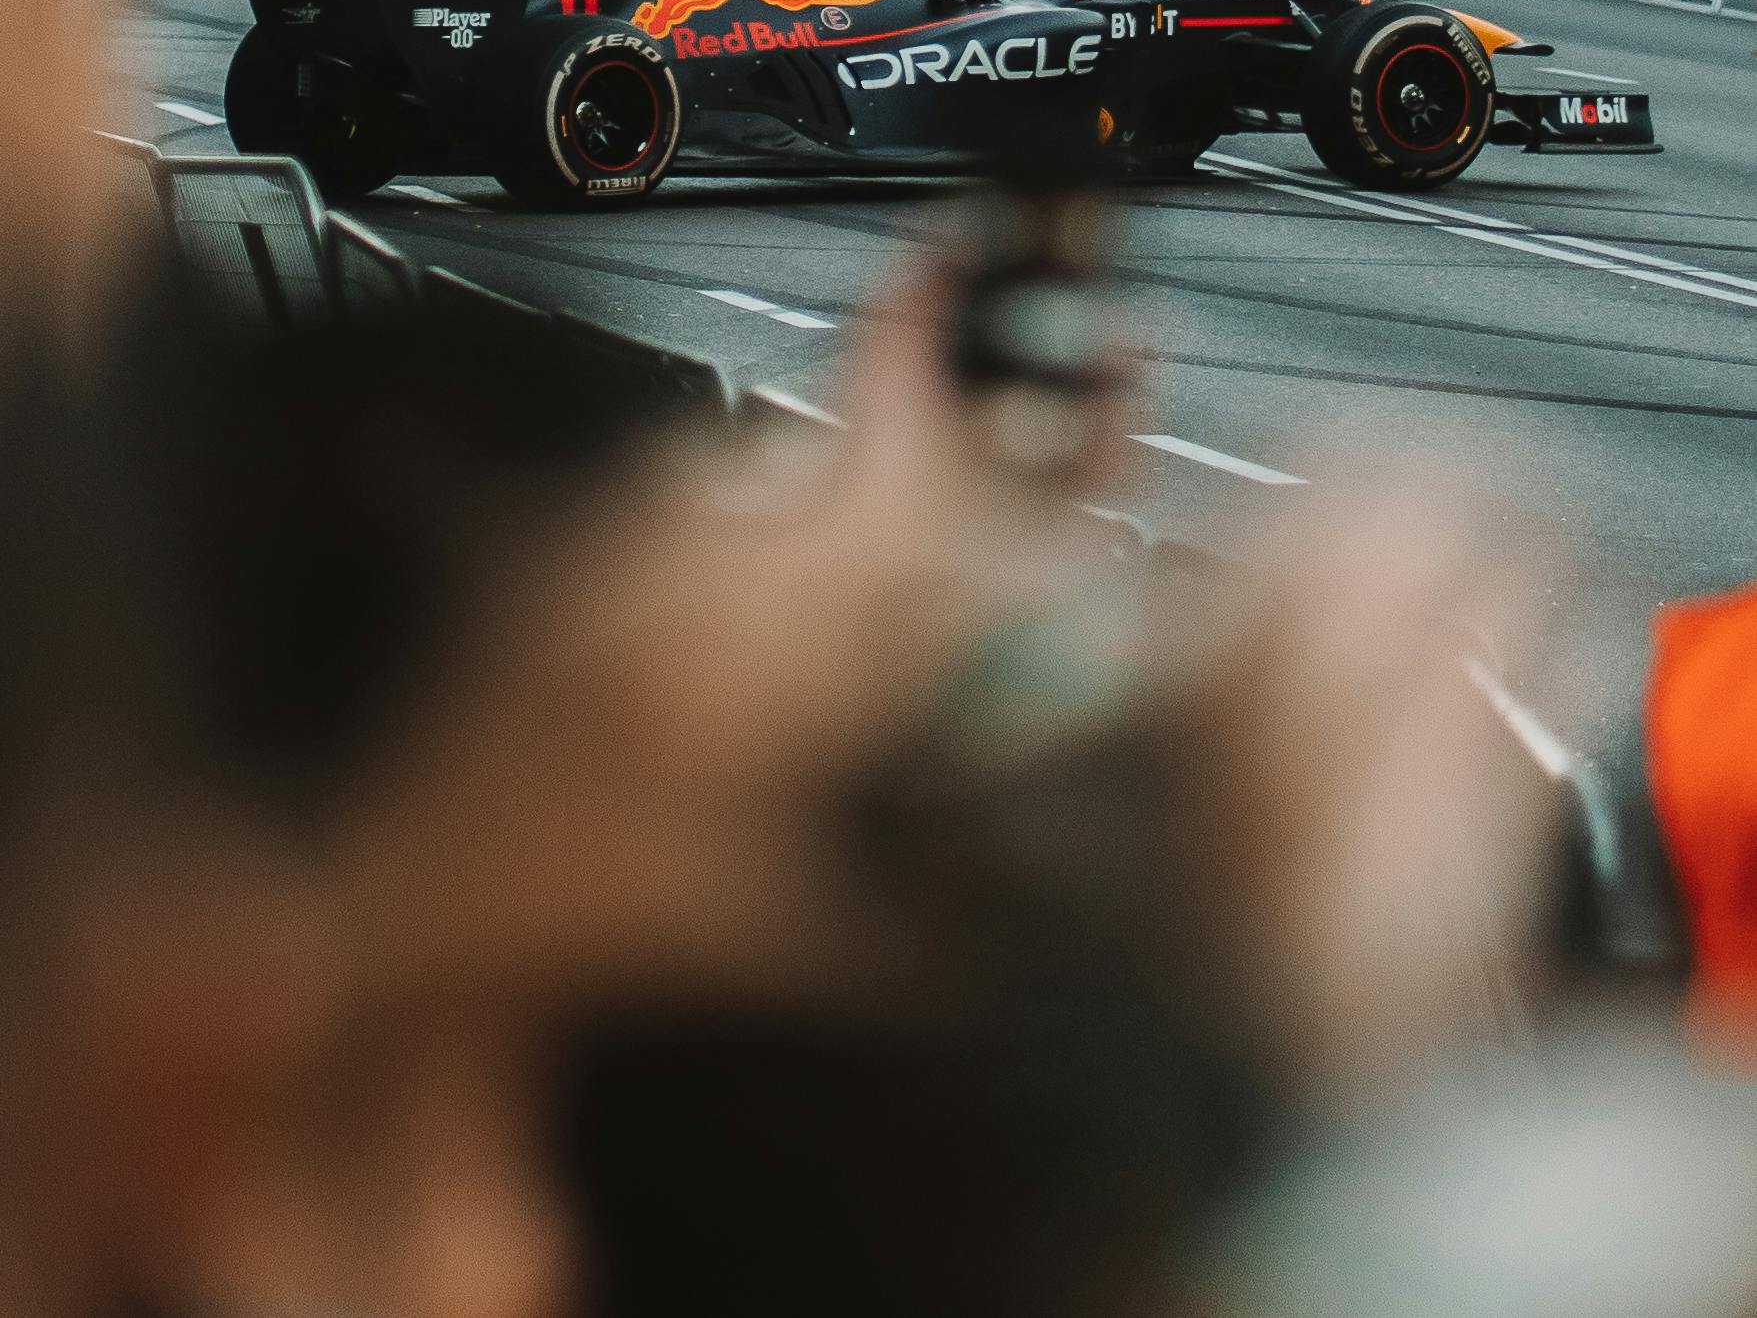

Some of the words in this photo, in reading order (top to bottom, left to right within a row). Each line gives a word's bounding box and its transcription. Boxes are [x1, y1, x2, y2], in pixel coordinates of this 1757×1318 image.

[431, 8, 491, 30] Player
[585, 33, 663, 63] ZERO
[837, 34, 1102, 91] ORACLE
[1559, 96, 1629, 126] Mobil
